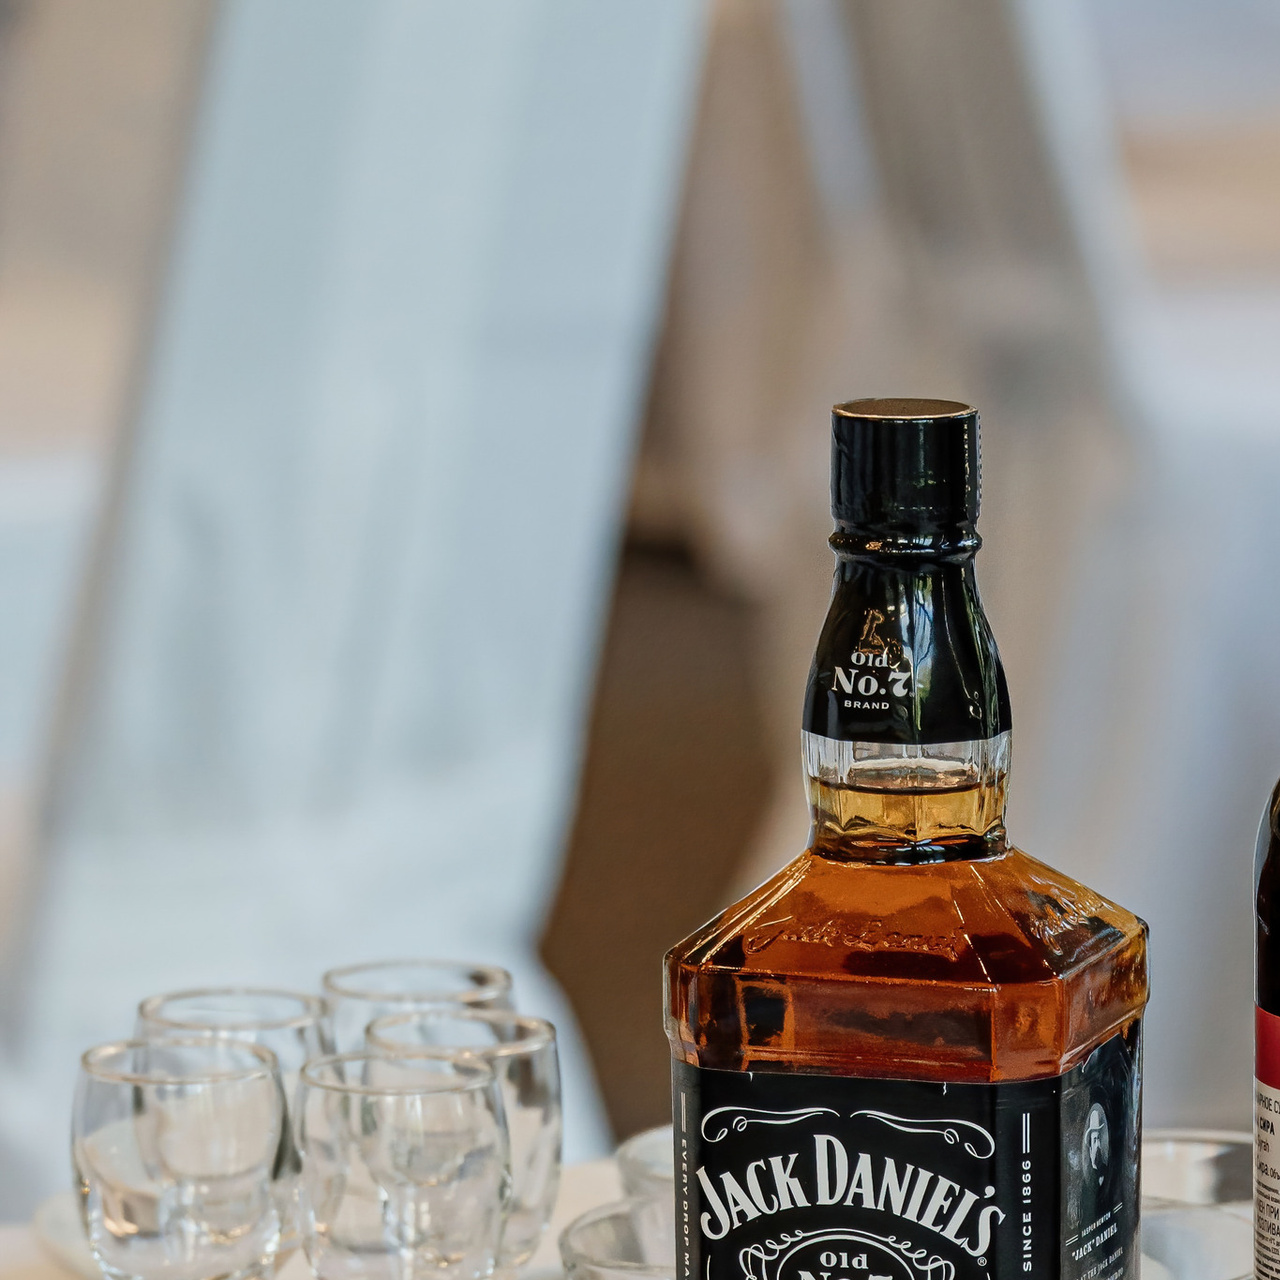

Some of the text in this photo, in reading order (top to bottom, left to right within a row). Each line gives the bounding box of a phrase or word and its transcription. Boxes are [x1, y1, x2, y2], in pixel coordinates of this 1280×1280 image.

[851, 652, 888, 667] Old
[831, 666, 911, 697] No.7
[844, 700, 890, 710] BRAND
[1022, 1160, 1032, 1204] 1866
[695, 1152, 812, 1240] JACK
[1023, 1212, 1032, 1272] SINCE
[1096, 1223, 1117, 1246] DANIEL
[819, 1251, 869, 1270] Old
